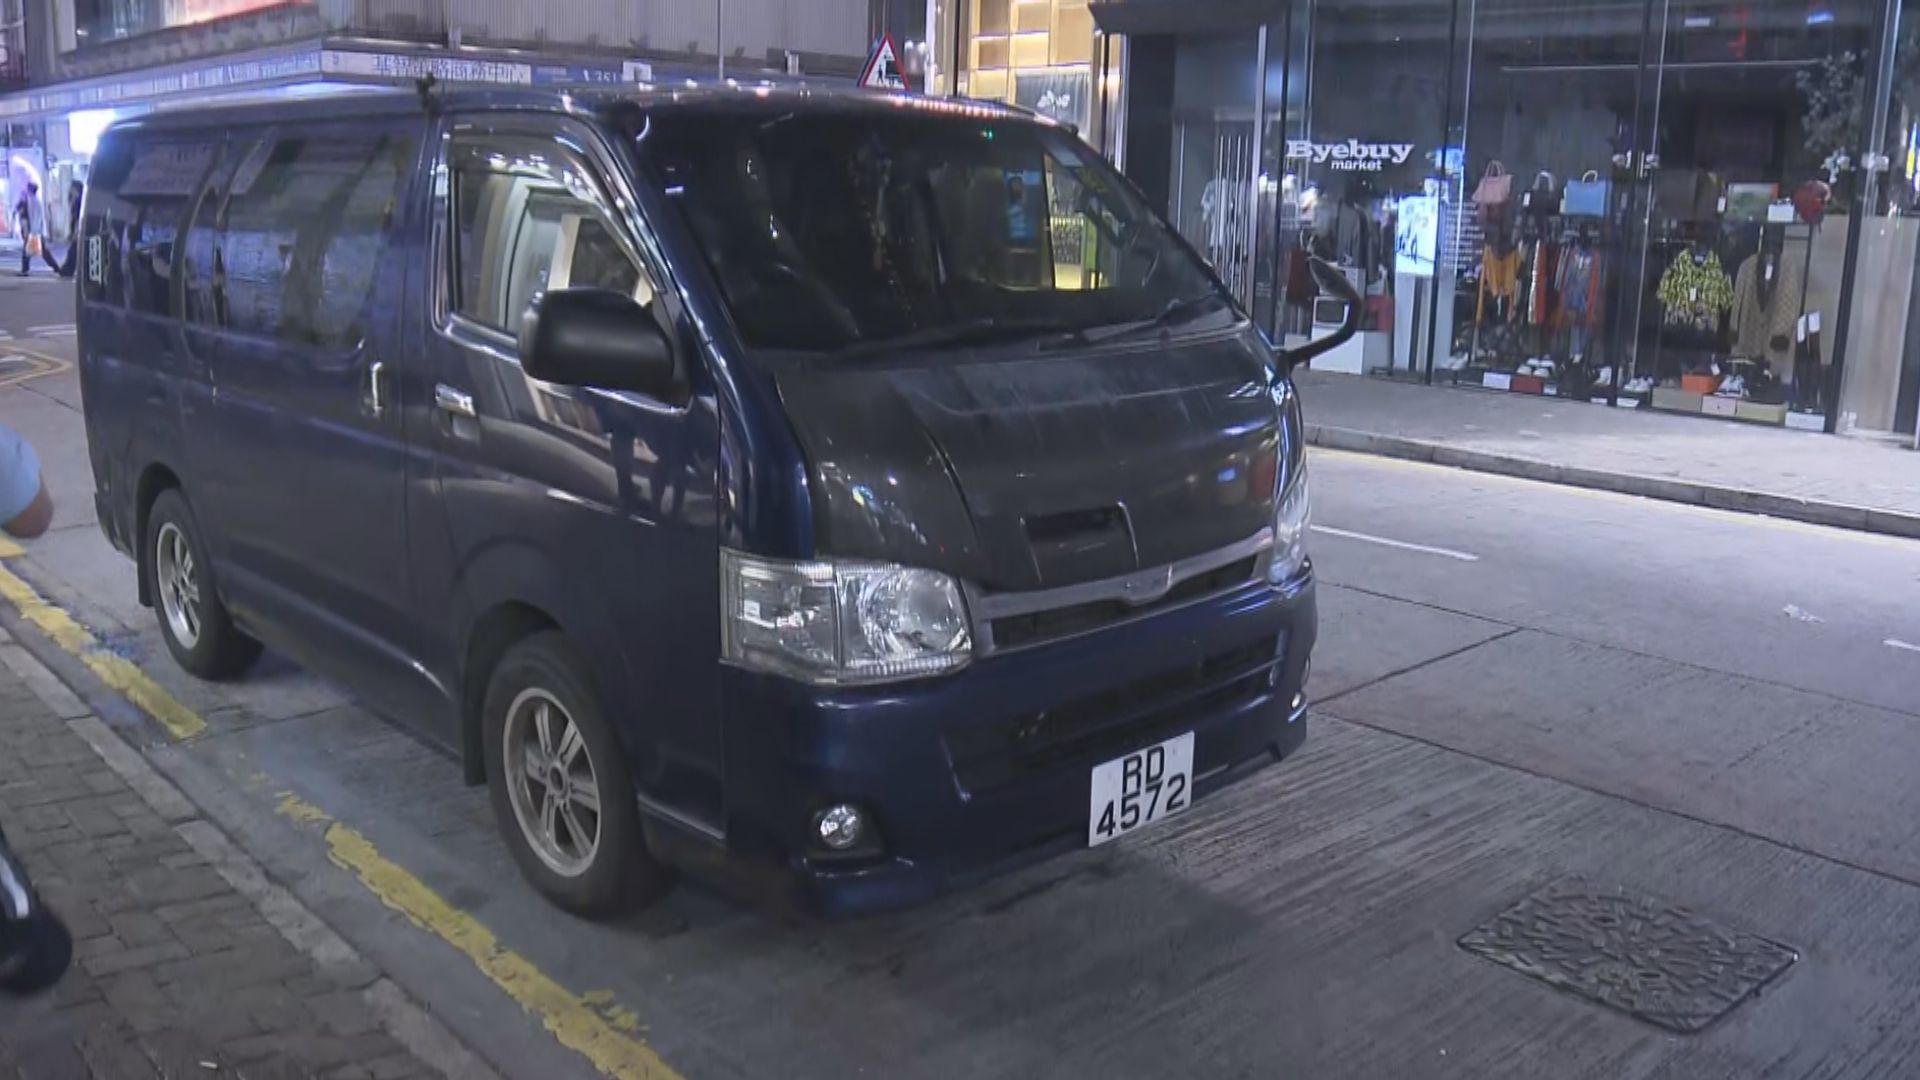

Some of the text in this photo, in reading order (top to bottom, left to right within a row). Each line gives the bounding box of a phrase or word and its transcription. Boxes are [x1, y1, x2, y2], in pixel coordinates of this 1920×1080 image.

[1286, 138, 1415, 164] Byebuy
[1331, 160, 1382, 171] market
[1122, 746, 1165, 796] RD
[1096, 772, 1186, 837] 4572
